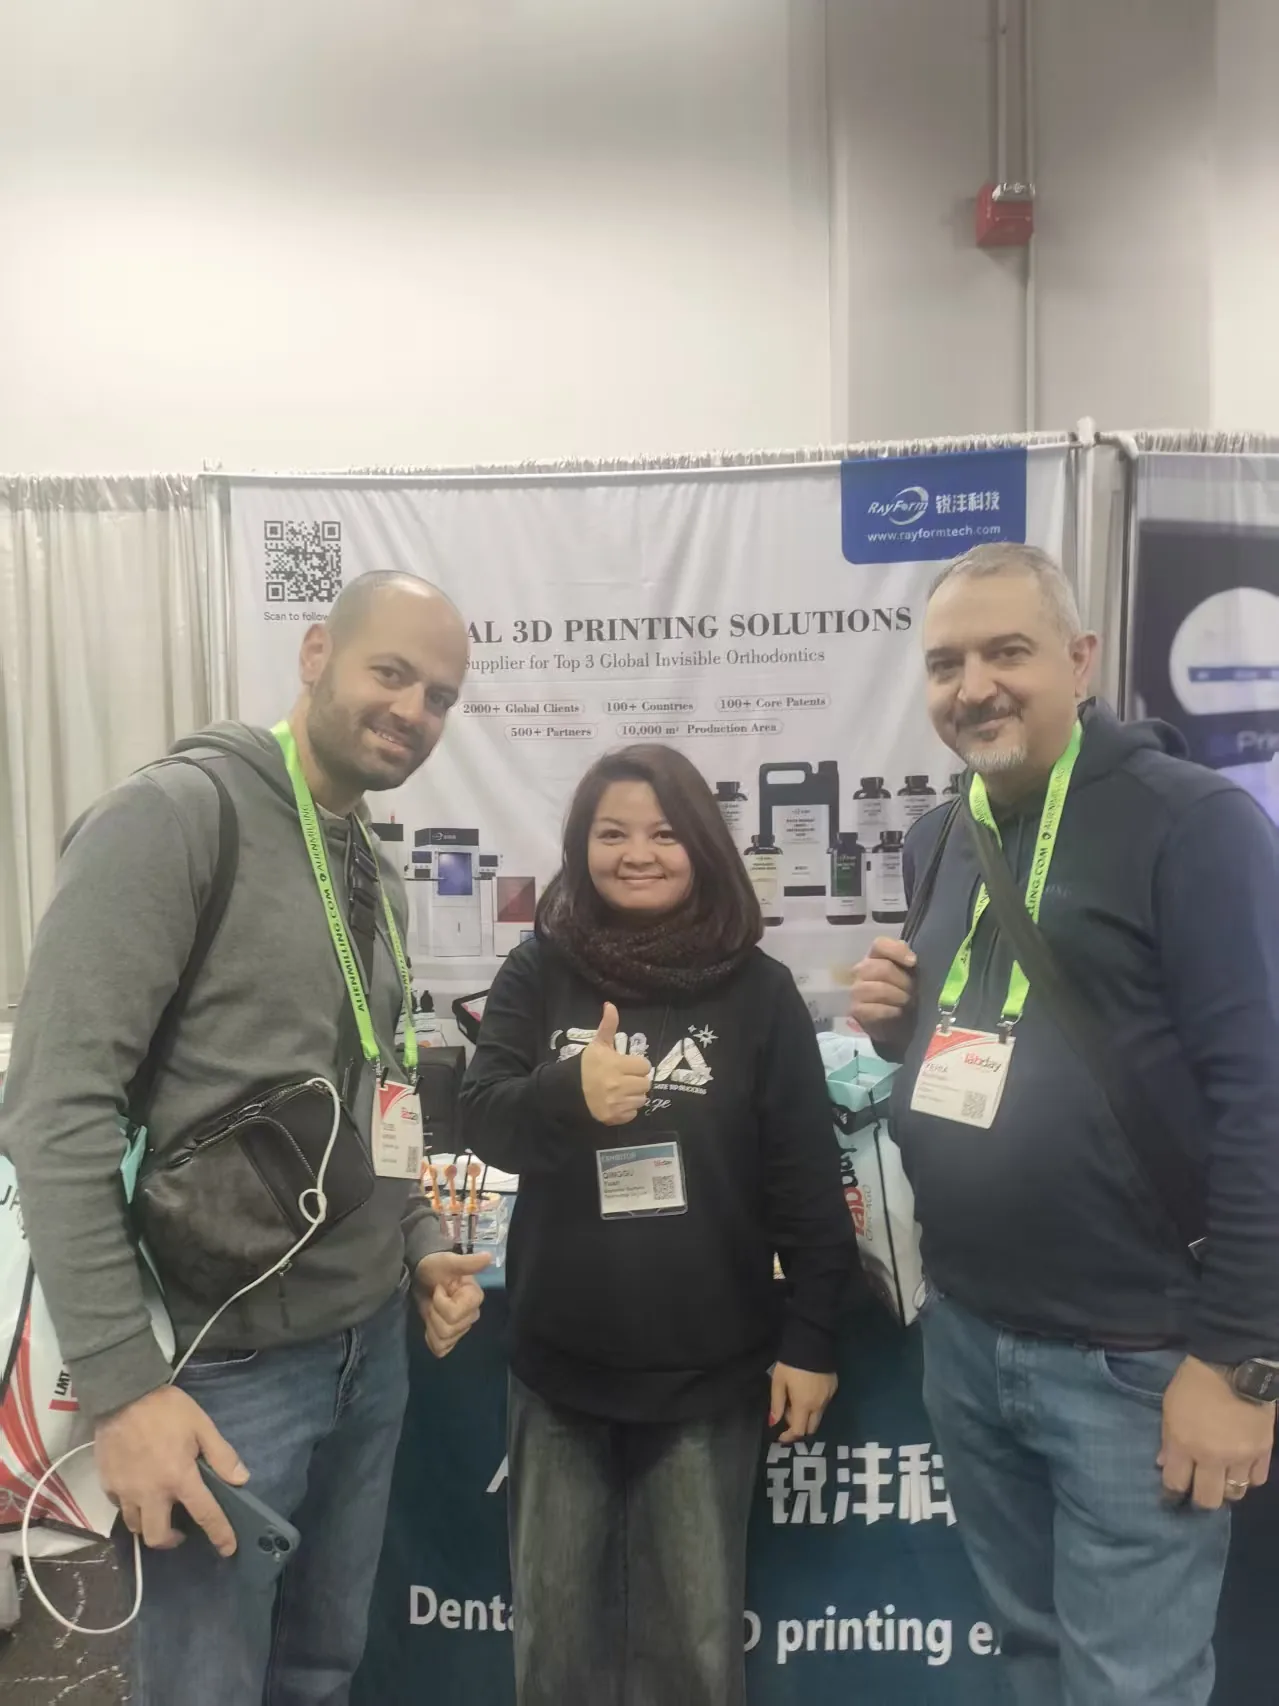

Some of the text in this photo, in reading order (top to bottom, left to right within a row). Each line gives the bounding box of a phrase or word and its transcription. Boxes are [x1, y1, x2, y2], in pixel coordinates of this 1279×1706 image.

[935, 491, 1001, 514] 锐沣科技
[867, 524, 1001, 543] www.rayformtech.com
[263, 611, 287, 621] Scan
[288, 612, 300, 621] to
[512, 619, 553, 644] 3D
[563, 614, 719, 643] PRINTING
[729, 606, 913, 638] SOLUTIONS
[530, 655, 550, 669] for
[554, 653, 581, 673] Top
[585, 654, 595, 669] 3
[600, 651, 650, 668] Global
[656, 649, 721, 667] Invisible
[726, 647, 825, 665] Orthodontics
[463, 703, 580, 714] 2000+ Global Clients
[606, 701, 694, 712] 100+ Countries
[719, 697, 826, 709] 100+ Core Patents
[511, 727, 592, 737] 500+ Partners
[621, 725, 663, 736] 10,000
[687, 723, 748, 735] Production
[751, 723, 777, 733] Area
[776, 1603, 953, 1666] printing
[968, 1620, 1002, 1656] e
